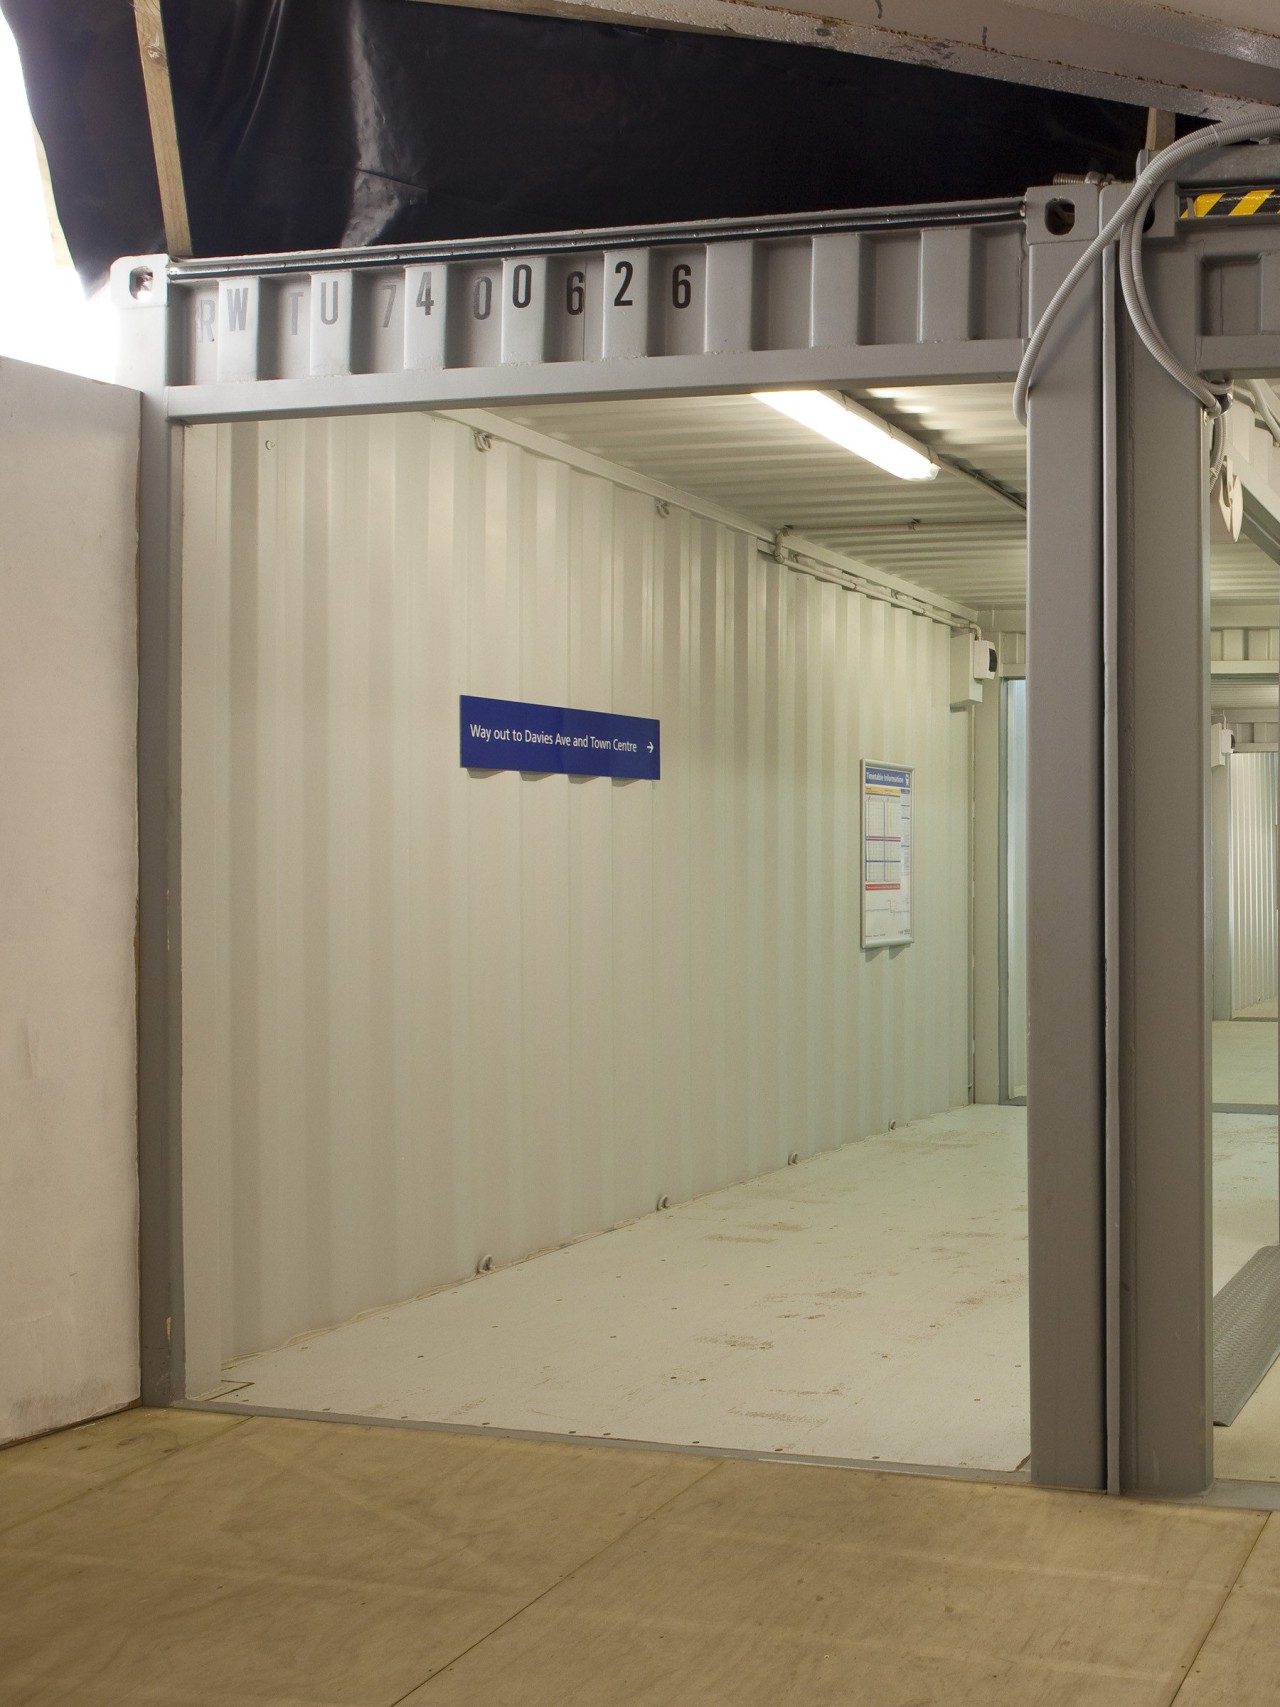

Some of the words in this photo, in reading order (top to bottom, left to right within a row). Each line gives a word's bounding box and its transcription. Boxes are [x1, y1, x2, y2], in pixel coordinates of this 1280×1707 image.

[470, 724, 492, 742] Way
[494, 729, 510, 741] out
[512, 730, 523, 742] to
[525, 730, 553, 744] Davies
[555, 733, 571, 746] Ave
[573, 735, 588, 748] and
[590, 736, 611, 750] Town
[613, 738, 637, 752] Centre
